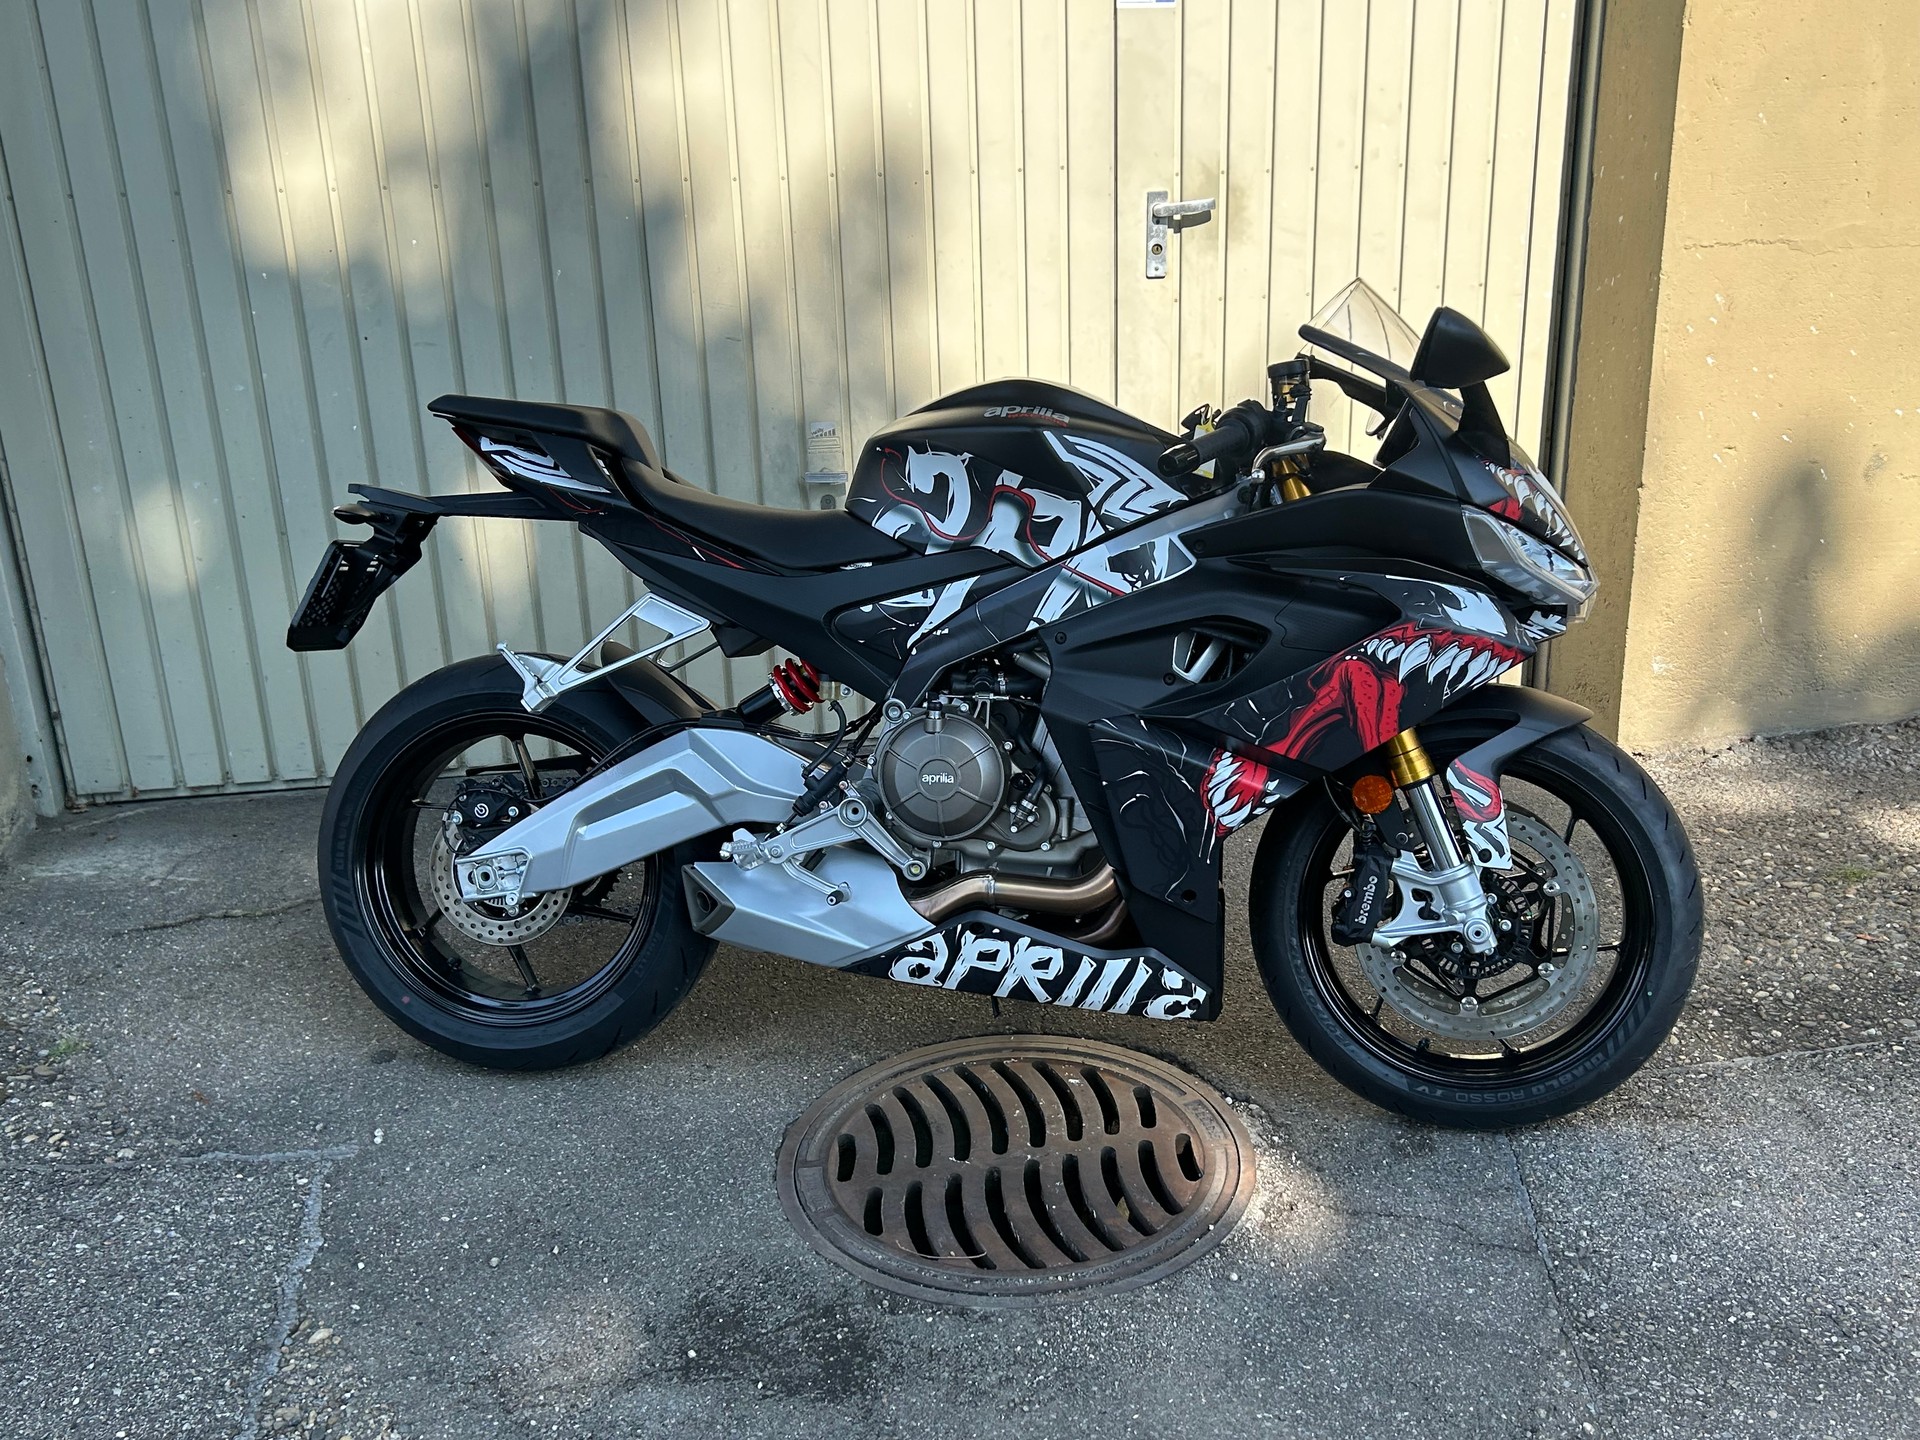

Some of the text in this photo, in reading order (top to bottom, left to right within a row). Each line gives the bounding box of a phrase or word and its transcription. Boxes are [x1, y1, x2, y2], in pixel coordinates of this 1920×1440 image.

[984, 405, 1070, 424] aprilia
[922, 772, 954, 785] aprilia
[1354, 875, 1378, 925] brembo
[1531, 1054, 1608, 1095] DIABLO
[1414, 1085, 1445, 1098] IV
[1455, 1088, 1525, 1104] ROSSO
